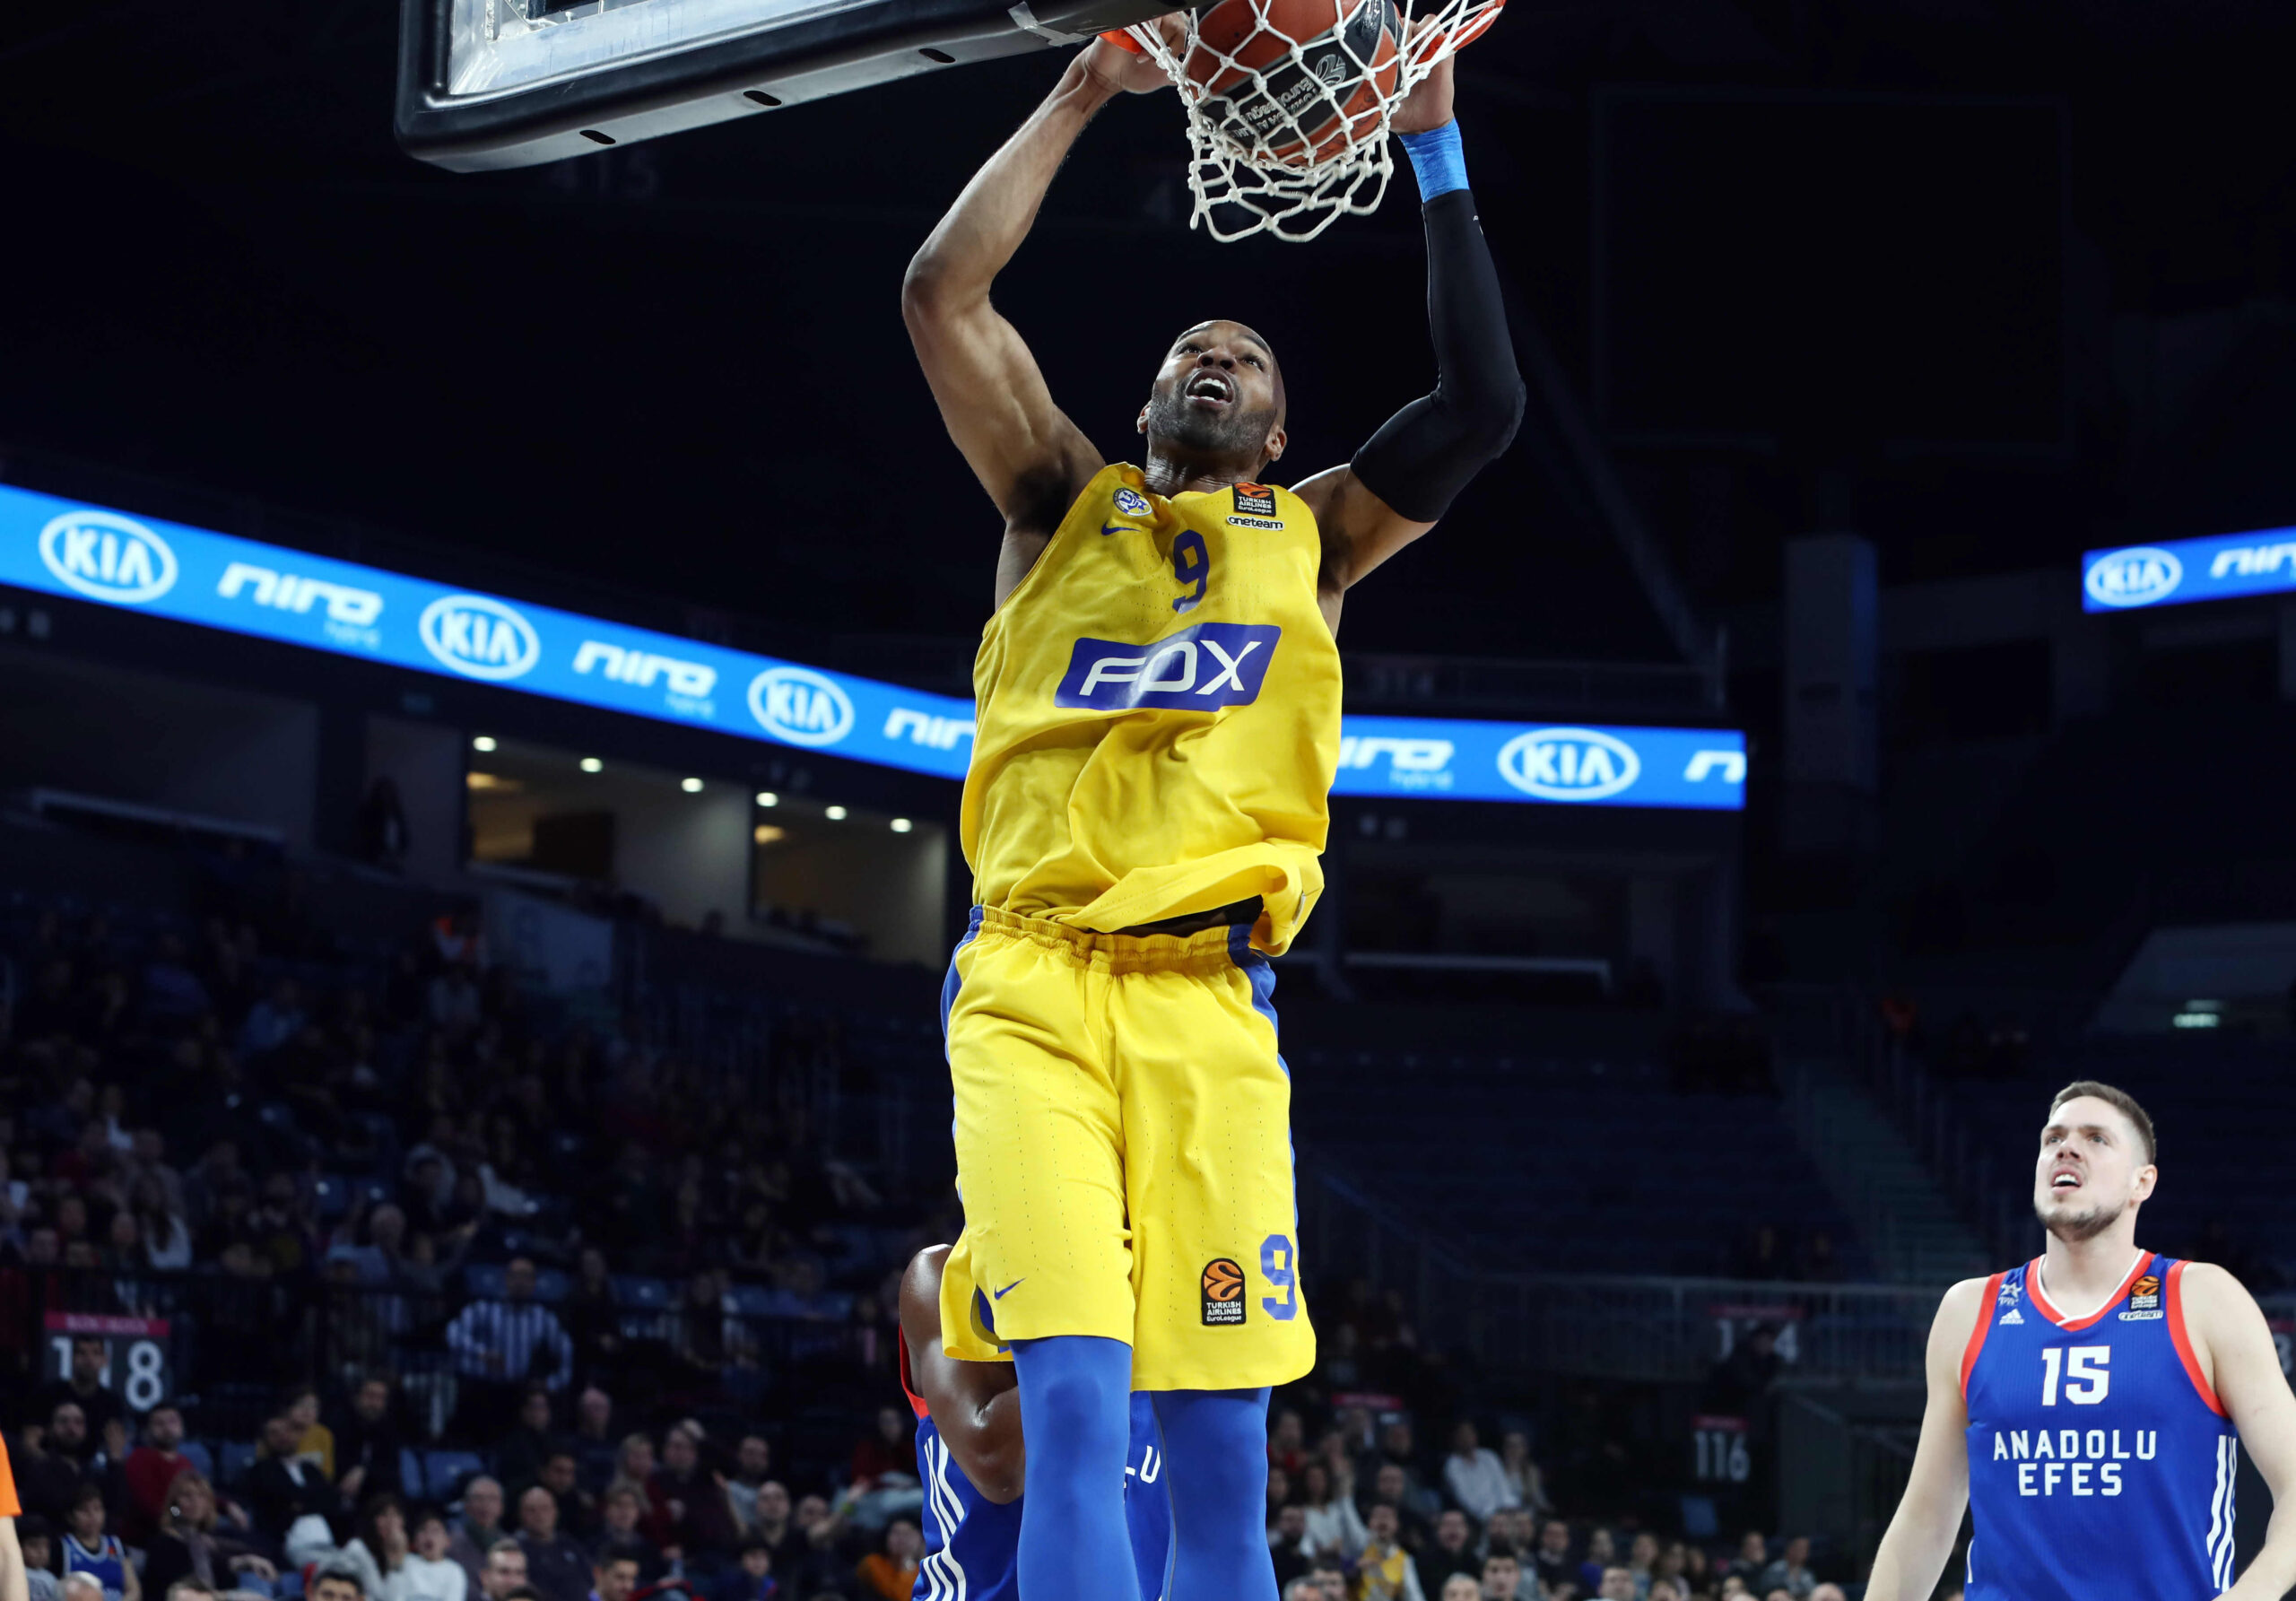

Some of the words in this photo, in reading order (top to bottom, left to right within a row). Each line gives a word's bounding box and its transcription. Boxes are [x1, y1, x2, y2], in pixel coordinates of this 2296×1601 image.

[1238, 496, 1272, 505] TURKISH
[1238, 505, 1272, 514] EuroLeague
[1239, 500, 1272, 509] AIRLINES
[1228, 516, 1283, 529] oneteam
[1172, 529, 1210, 614] 9
[2209, 542, 2296, 579] nir
[217, 561, 384, 626] niro
[571, 640, 717, 699] niro
[883, 708, 976, 750] nir
[1078, 640, 1263, 696] FOX
[1337, 736, 1454, 770] iro
[1260, 1233, 1298, 1320] 9
[1206, 1301, 1241, 1310] TURKISH
[1206, 1308, 1242, 1316] AIRLINES
[1714, 1318, 1797, 1364] 14
[2041, 1345, 2111, 1406] 15
[1694, 1431, 1750, 1483] 116
[1994, 1430, 2157, 1461] ANADOLU
[2018, 1463, 2123, 1496] EFES
